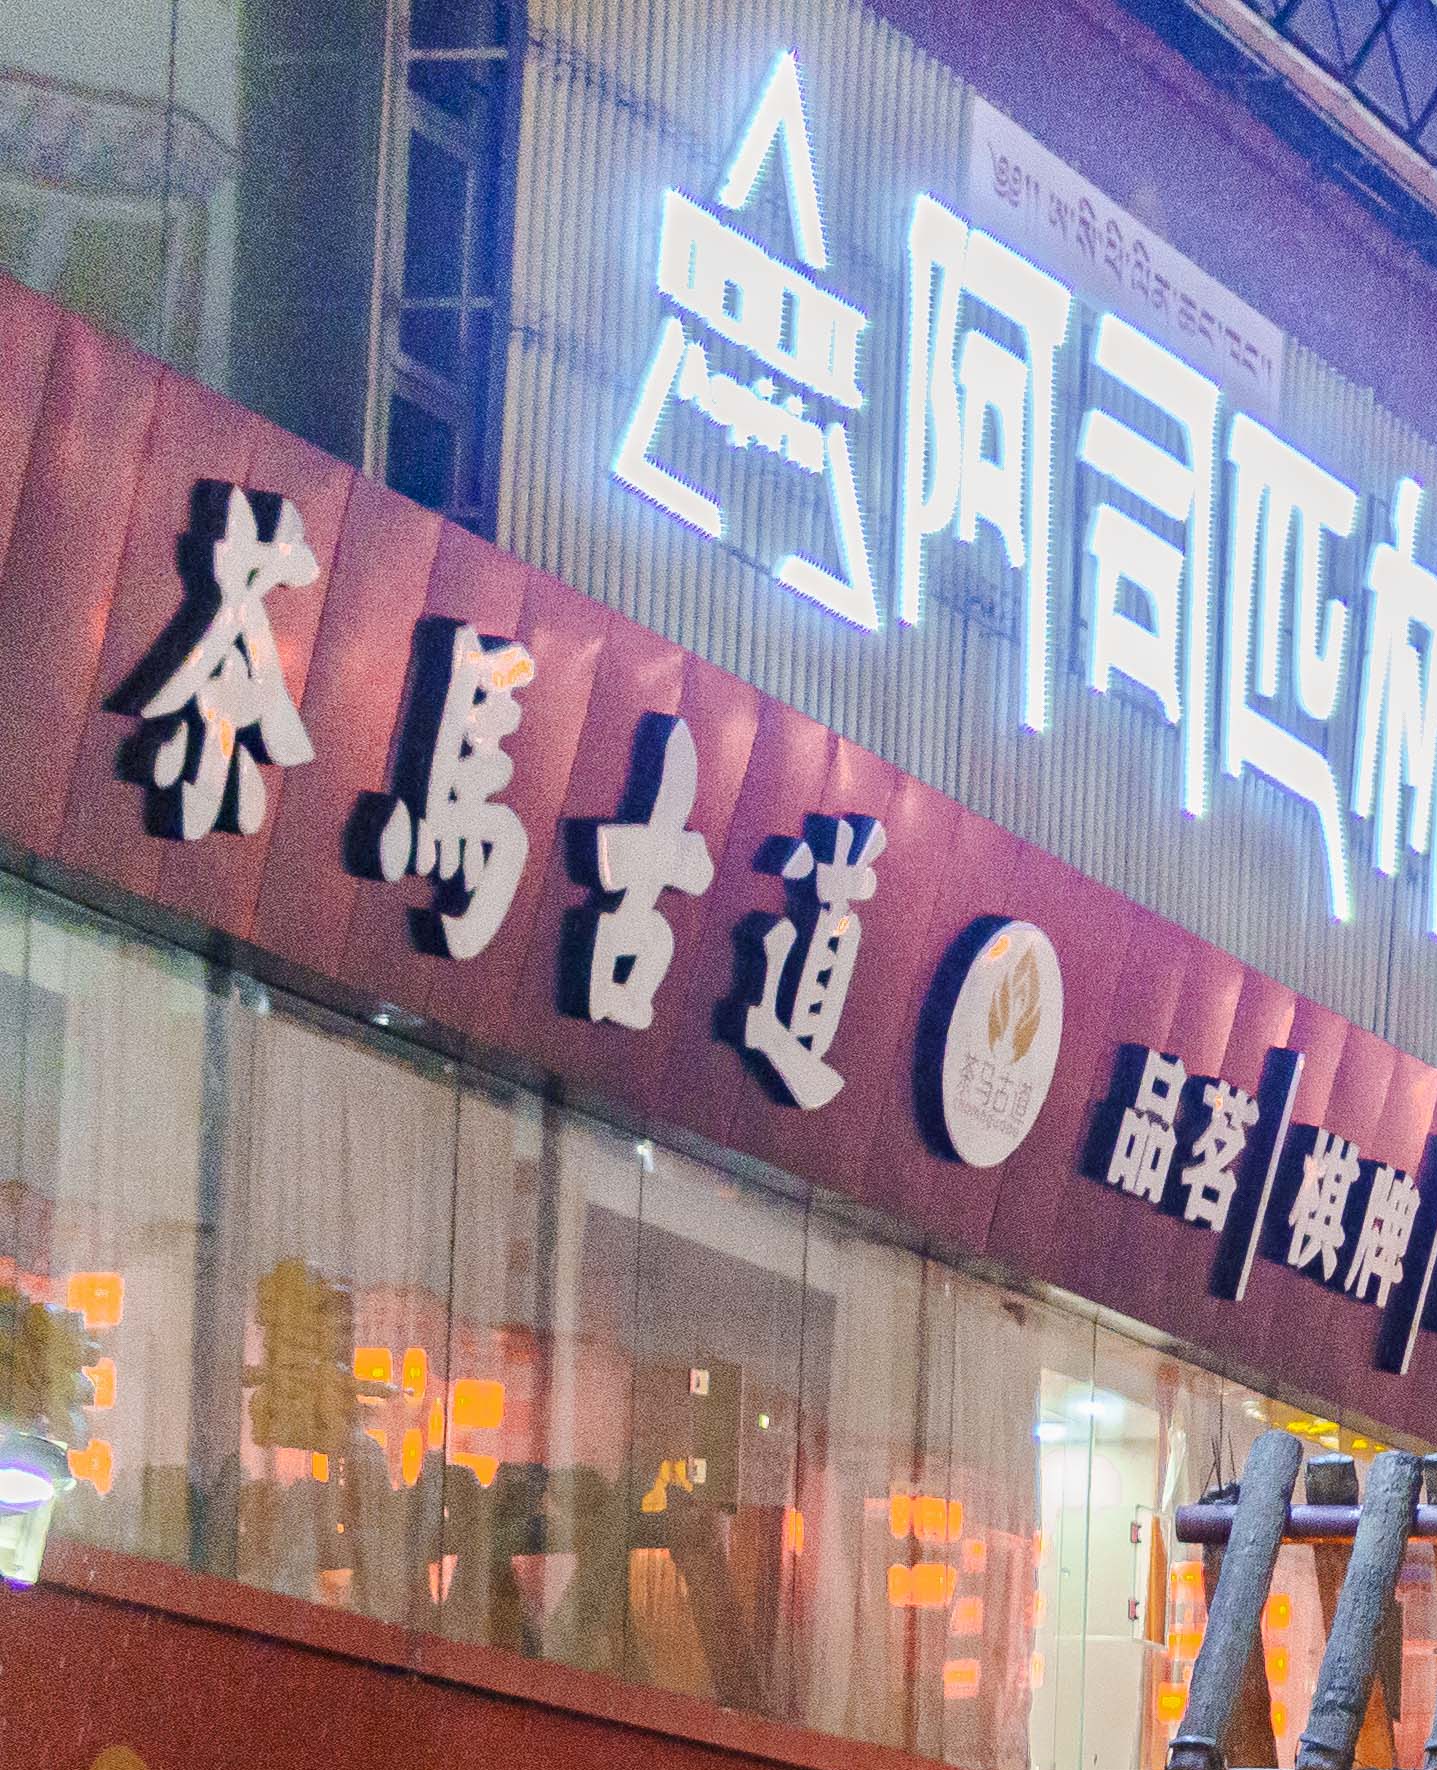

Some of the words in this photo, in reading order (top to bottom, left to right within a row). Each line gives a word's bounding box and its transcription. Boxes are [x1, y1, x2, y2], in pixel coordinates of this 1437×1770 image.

[138, 484, 888, 1112] 茶馬古道
[1107, 1048, 1260, 1233] 品茗
[1287, 1127, 1421, 1306] 棋牌
